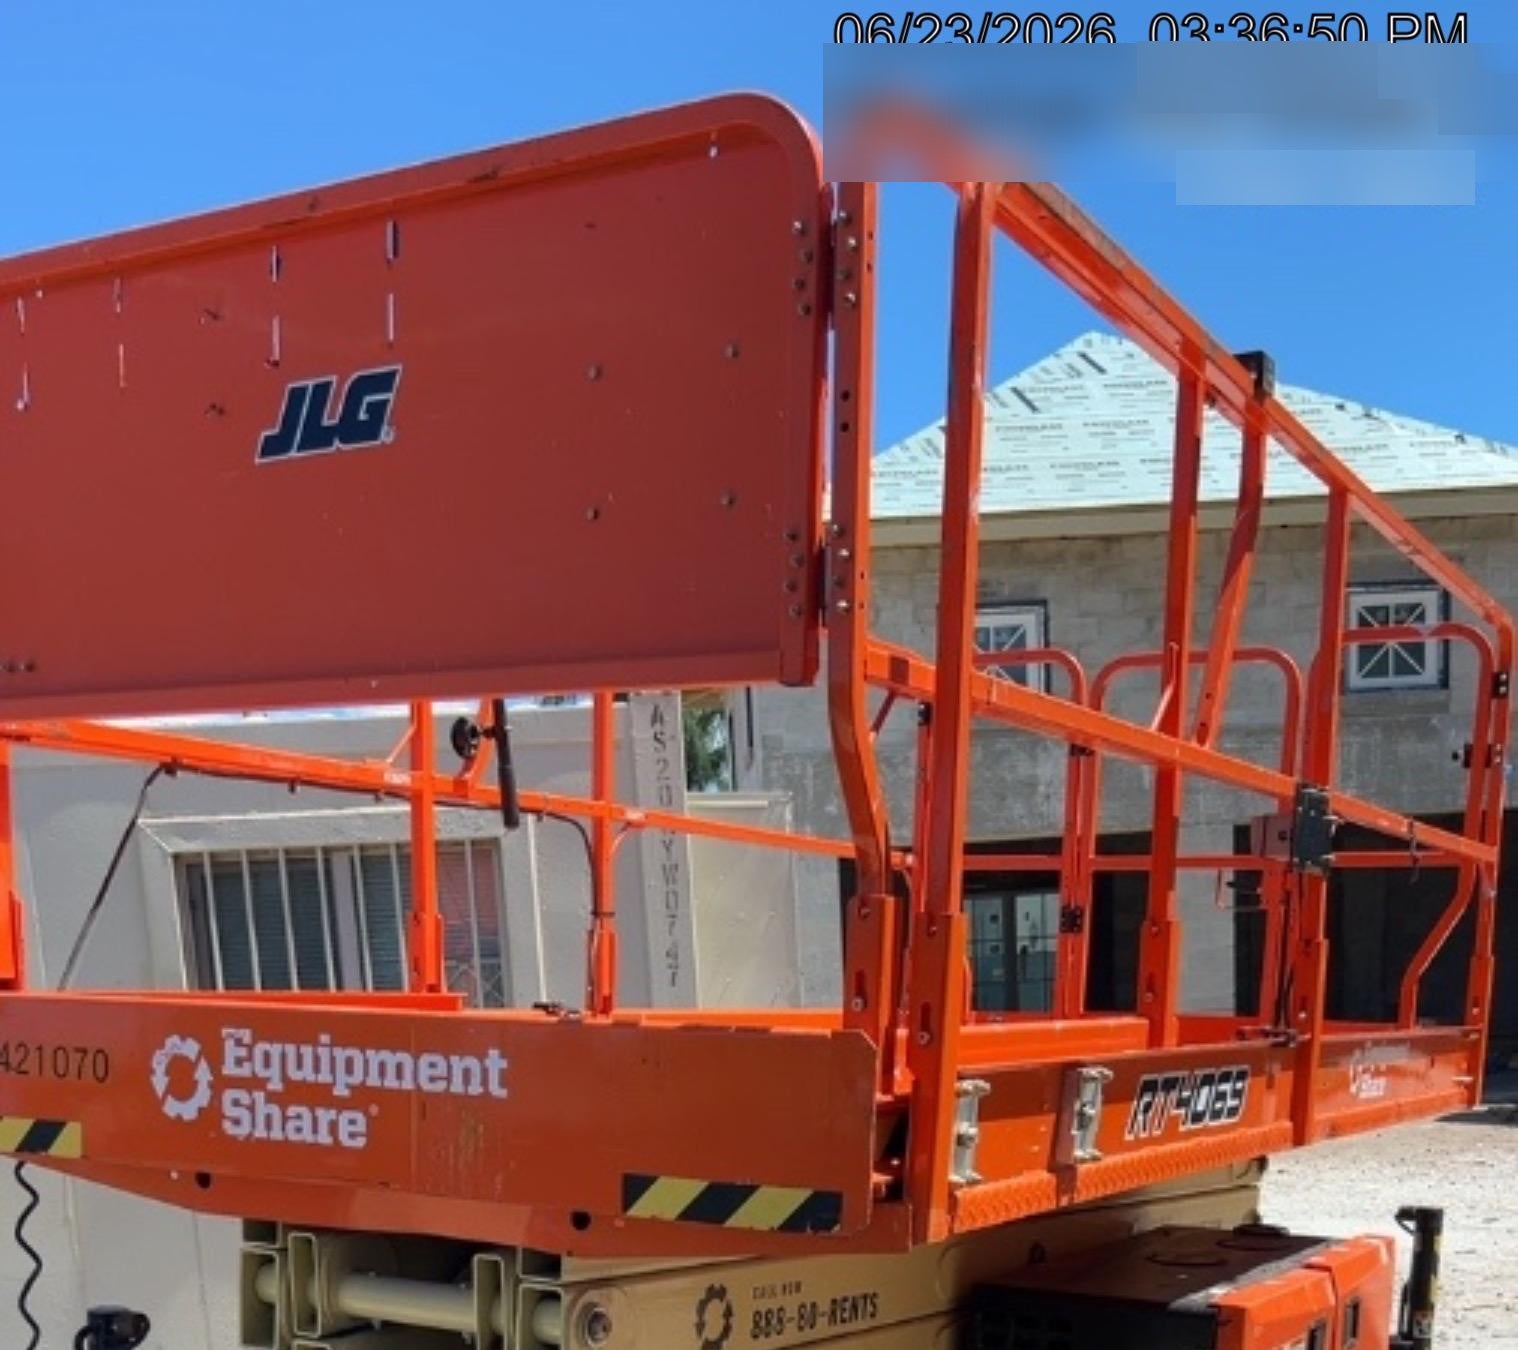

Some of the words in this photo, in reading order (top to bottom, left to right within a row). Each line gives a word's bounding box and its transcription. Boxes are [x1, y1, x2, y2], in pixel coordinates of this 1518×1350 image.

[255, 364, 402, 465] JLG
[221, 1027, 508, 1098] Equipment
[221, 1088, 367, 1148] Share
[1124, 1064, 1250, 1141] RT4069
